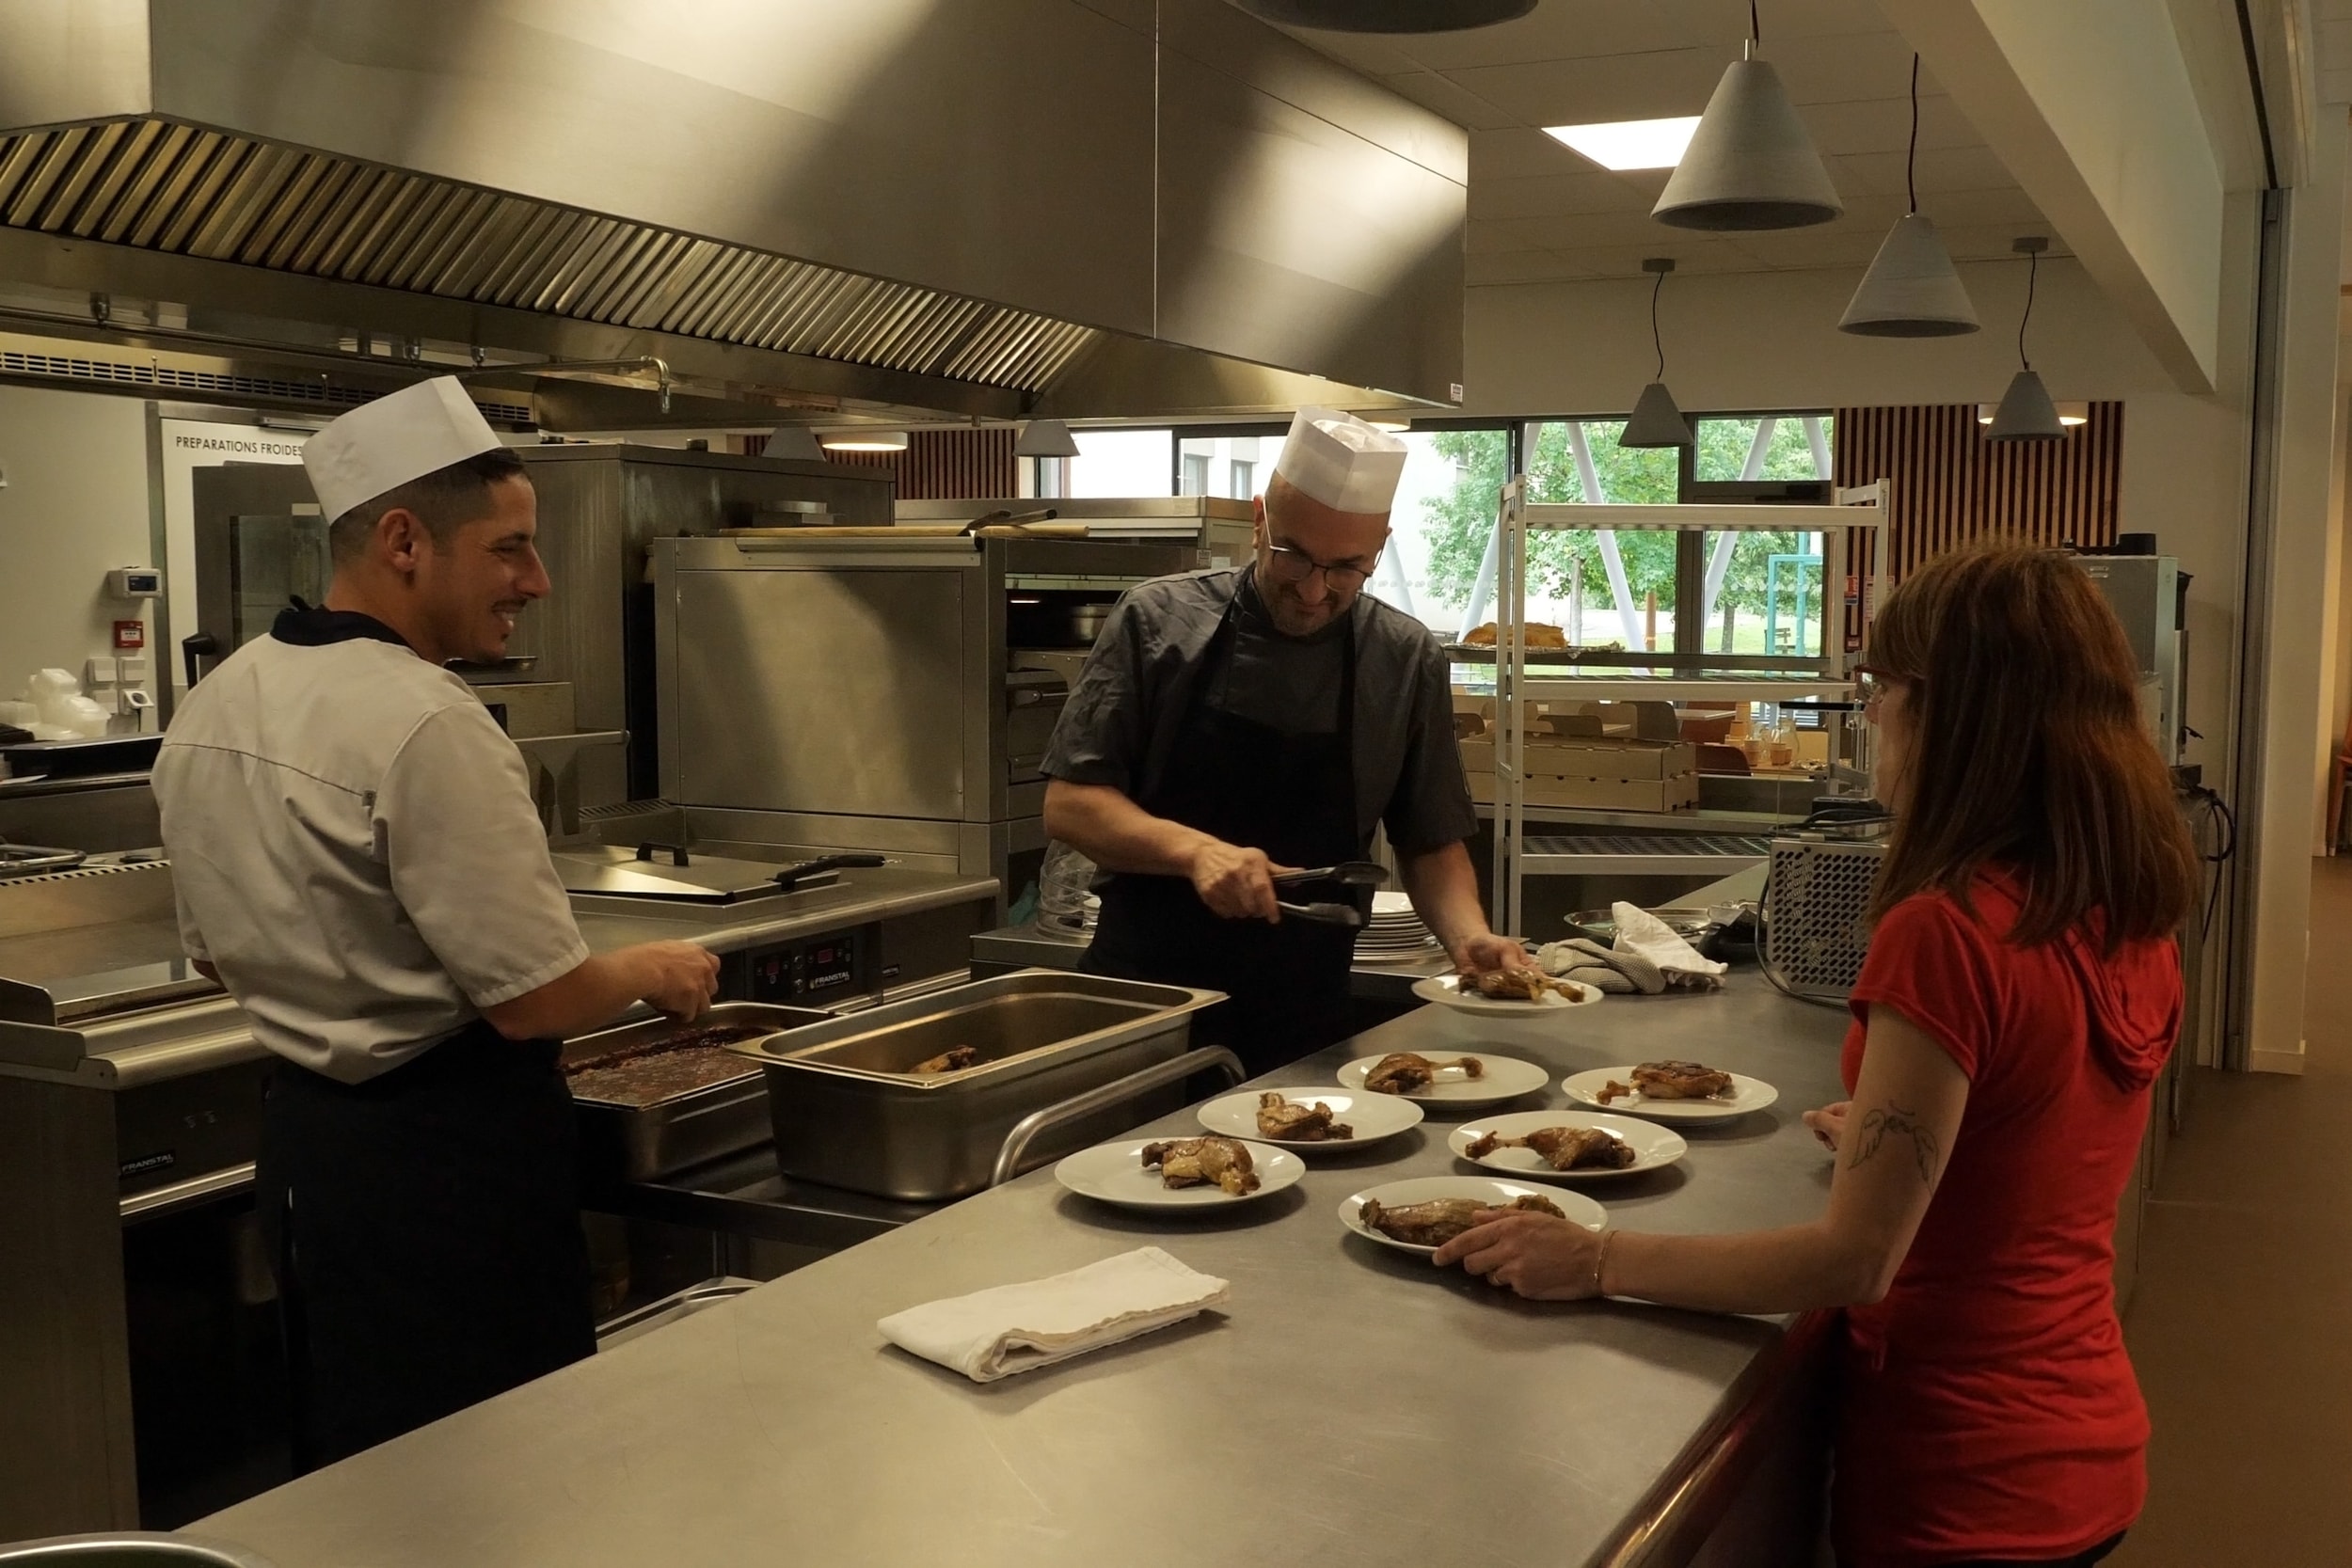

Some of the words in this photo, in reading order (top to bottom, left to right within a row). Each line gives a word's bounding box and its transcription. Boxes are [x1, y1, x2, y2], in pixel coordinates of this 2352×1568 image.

[176, 436, 258, 452] PREPARATIONS
[261, 443, 302, 455] FROIDES
[815, 972, 850, 985] FRANSTAL
[121, 1153, 174, 1173] FRANSTAL
